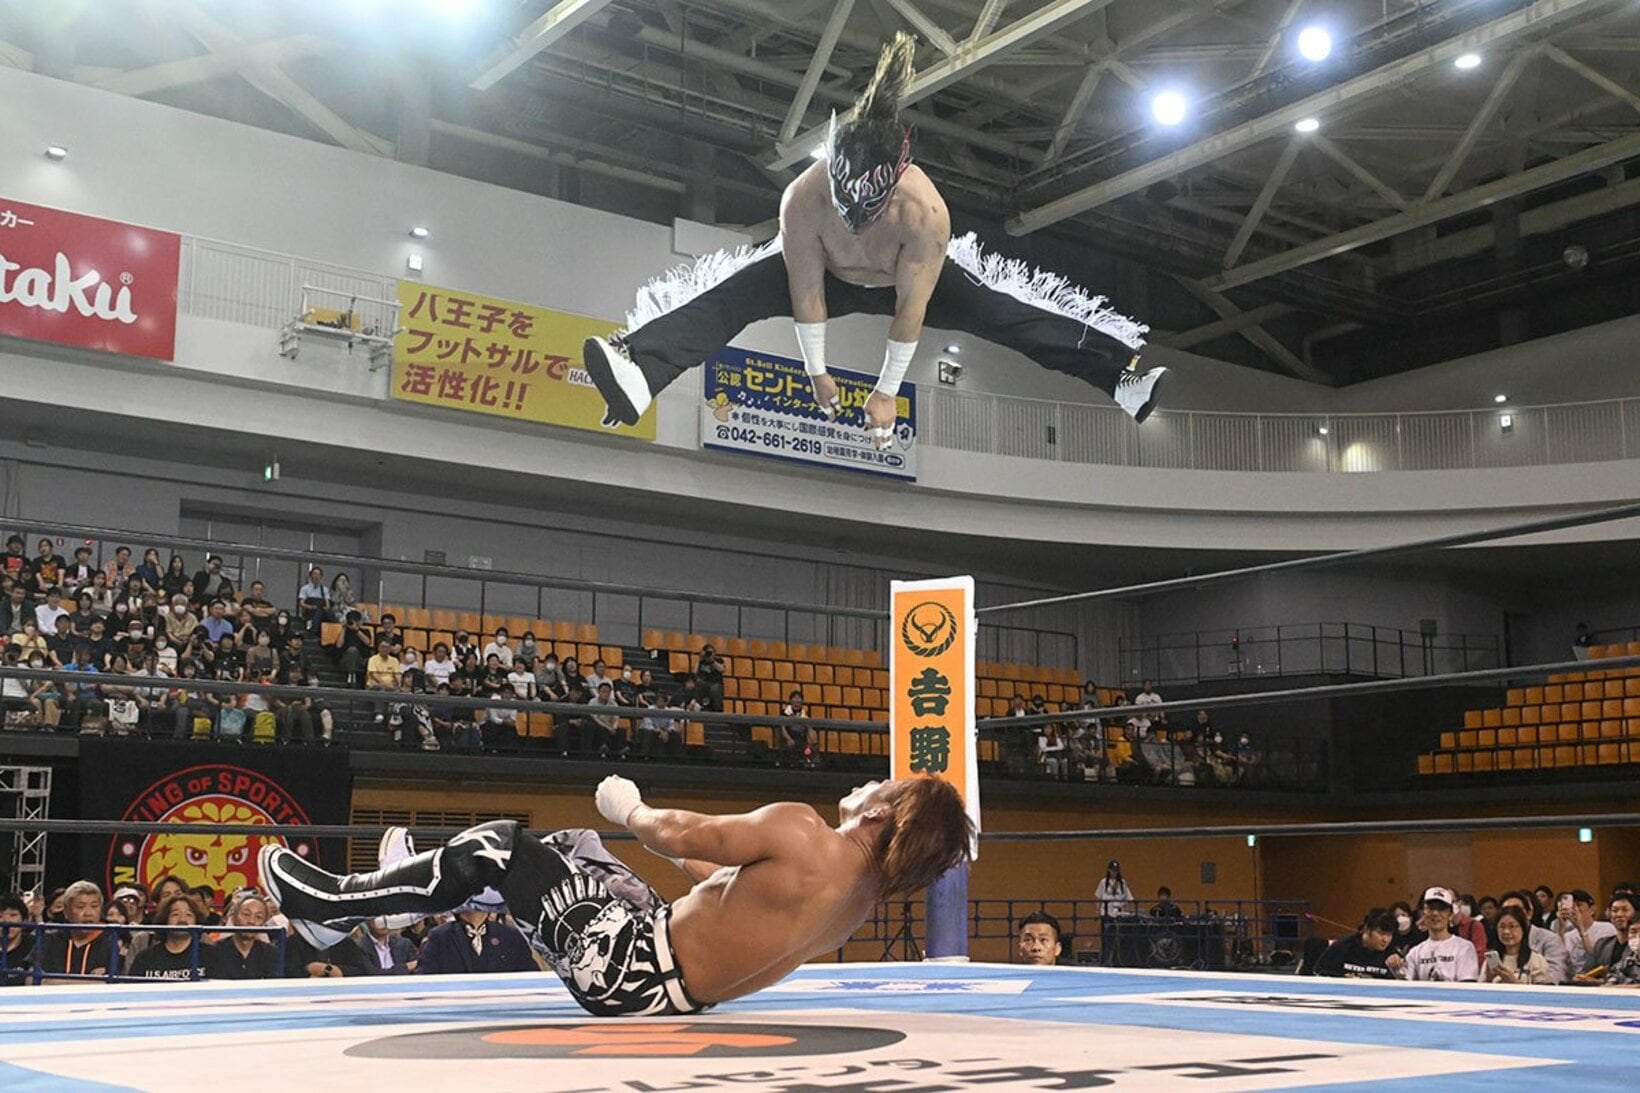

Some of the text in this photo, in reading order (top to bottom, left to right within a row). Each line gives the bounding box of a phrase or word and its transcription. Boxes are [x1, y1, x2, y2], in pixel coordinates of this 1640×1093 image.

[408, 292, 534, 339] 八王子を
[406, 329, 570, 381] フットサルで
[569, 370, 593, 385] HAC
[730, 426, 822, 455] 042-661-2619
[132, 782, 184, 825] ING
[188, 777, 213, 792] OF
